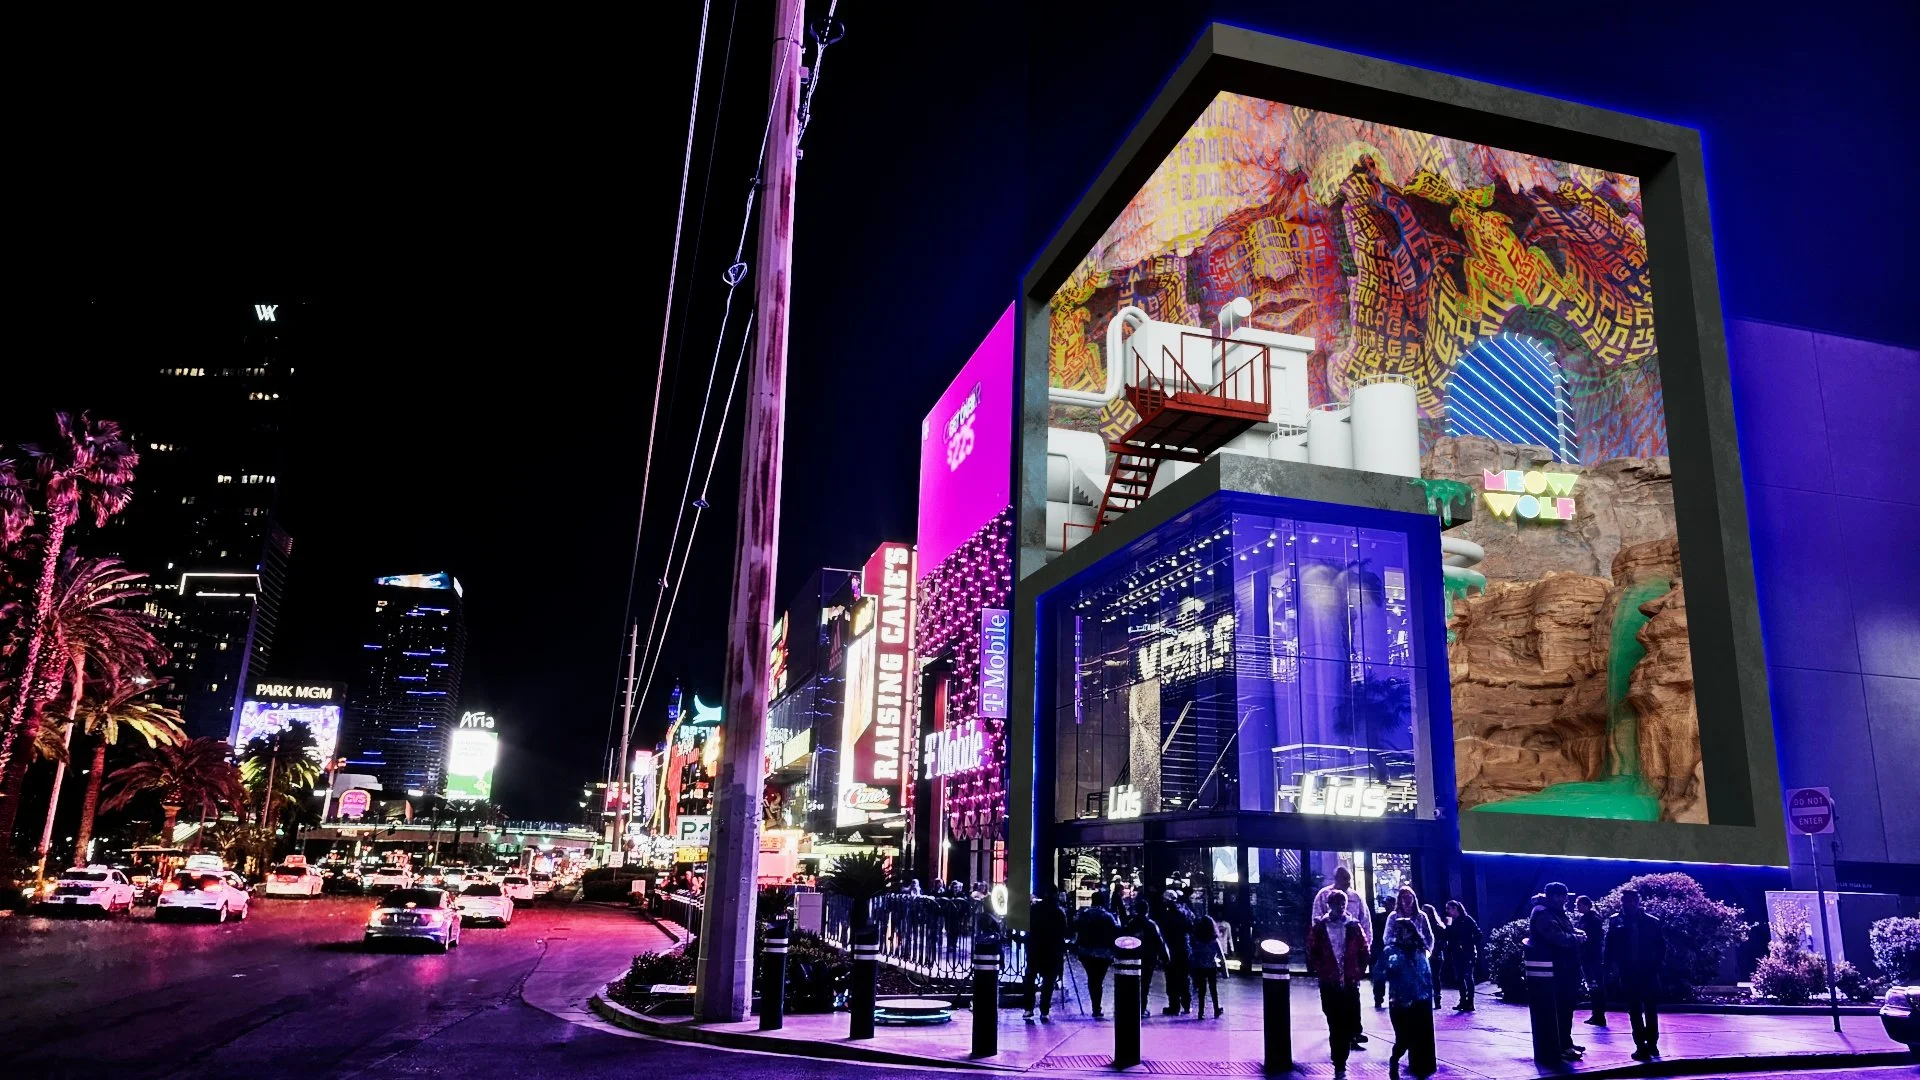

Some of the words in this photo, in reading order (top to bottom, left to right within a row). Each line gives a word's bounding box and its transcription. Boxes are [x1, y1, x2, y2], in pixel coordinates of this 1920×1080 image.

[1483, 468, 1579, 496] MEOW
[1481, 492, 1577, 521] WOLF
[880, 546, 909, 645] CANE'S
[255, 684, 294, 697] PARK
[295, 686, 333, 700] MGM
[459, 711, 495, 729] Aria
[873, 654, 904, 780] RAISING
[346, 794, 367, 803] CVS
[632, 776, 644, 817] ROSS
[1107, 784, 1142, 820] Lids
[1300, 773, 1388, 818] Lids
[1793, 798, 1804, 806] DO
[1807, 796, 1825, 806] NOT
[1799, 816, 1823, 826] ENTER
